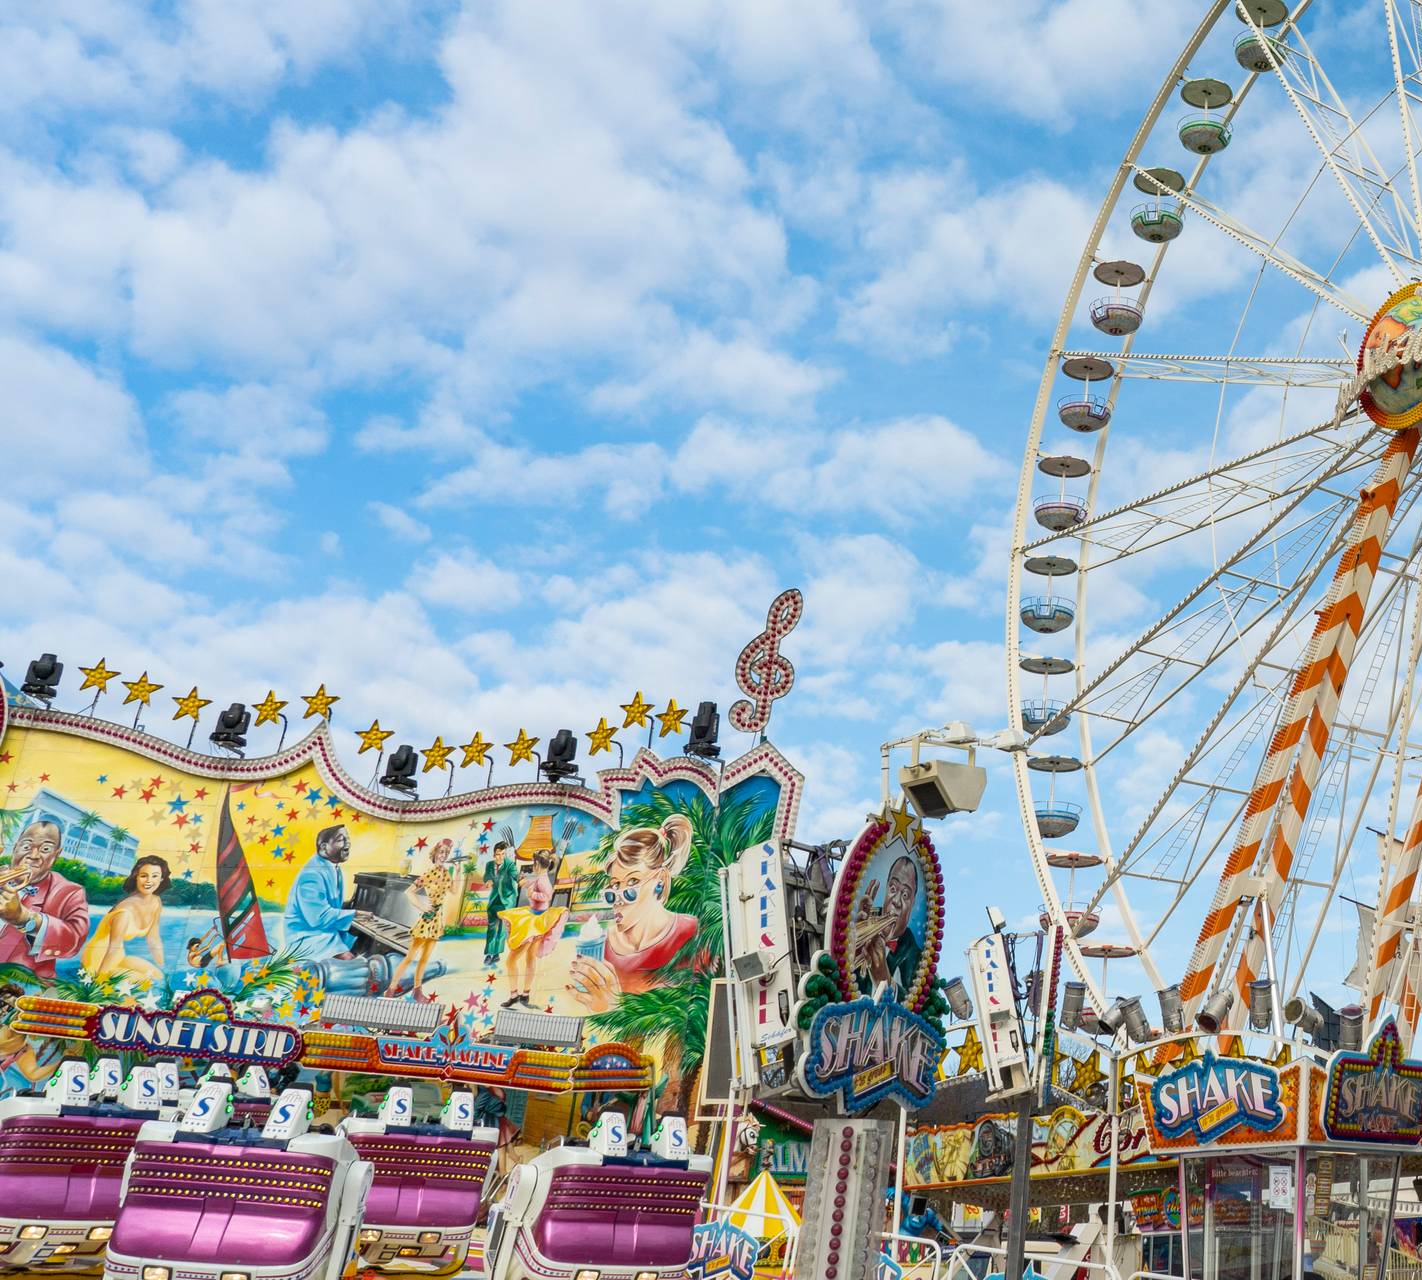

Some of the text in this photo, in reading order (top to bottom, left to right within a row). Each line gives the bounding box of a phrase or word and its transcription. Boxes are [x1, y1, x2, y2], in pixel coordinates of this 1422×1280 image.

[100, 1011, 296, 1058] SUNSET STRIP
[814, 1006, 937, 1095] SHAKE
[71, 1074, 85, 1093] S
[142, 1079, 155, 1097] S
[1160, 1066, 1277, 1125] SHAKE
[1340, 1068, 1418, 1121] SHAKE
[192, 1097, 215, 1117] S
[273, 1104, 296, 1124] S
[394, 1099, 407, 1114] S
[457, 1103, 470, 1119] S
[610, 1126, 622, 1144] S
[671, 1130, 683, 1147] S
[689, 1229, 755, 1276] SHAKE
